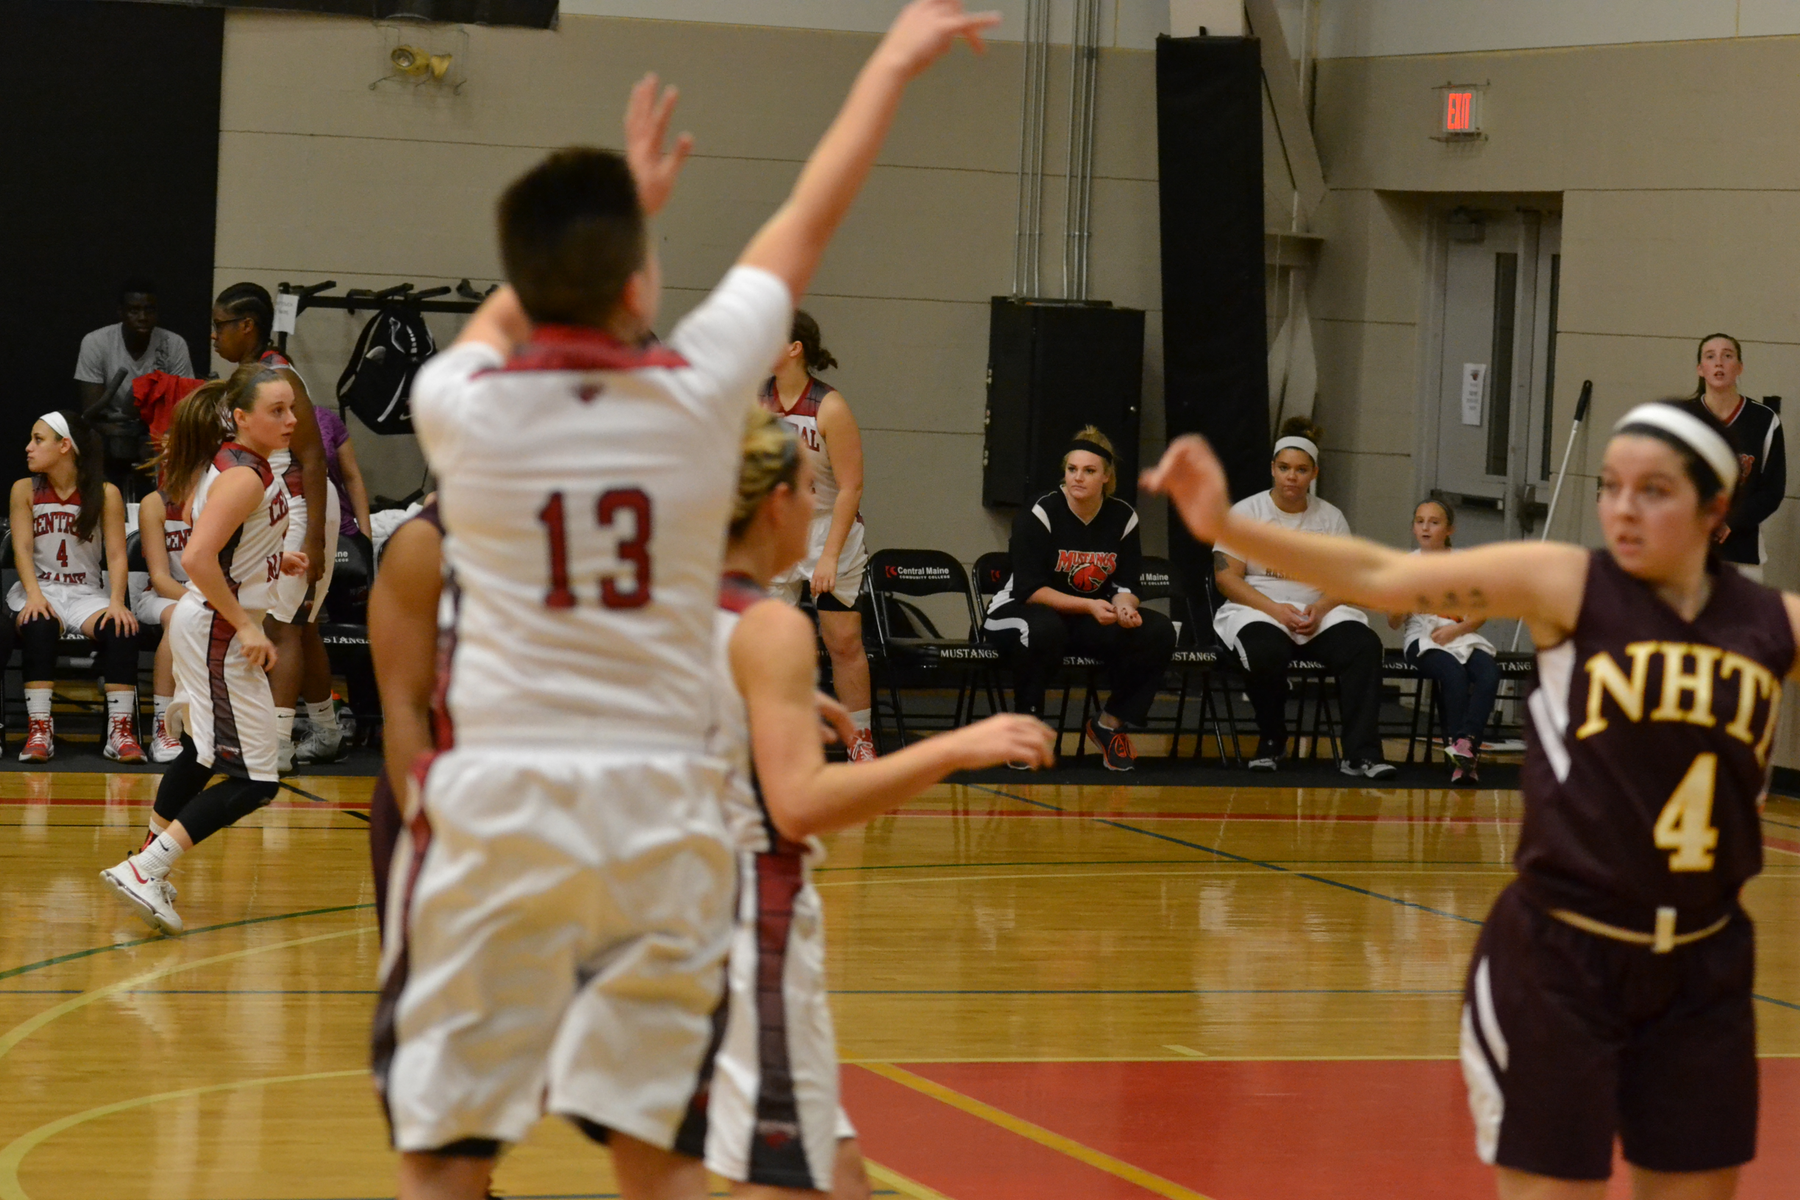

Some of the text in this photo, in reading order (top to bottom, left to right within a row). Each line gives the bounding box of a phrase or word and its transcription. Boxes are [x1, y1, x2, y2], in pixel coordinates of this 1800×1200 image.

[1447, 92, 1472, 130] EXIT
[56, 539, 69, 568] 4
[538, 488, 653, 610] 13
[1054, 549, 1117, 575] MUSTANGS
[897, 566, 950, 575] Central Maine
[1146, 572, 1169, 581] Maine
[940, 648, 999, 659] MUSTANGS
[1653, 752, 1720, 872] 4
